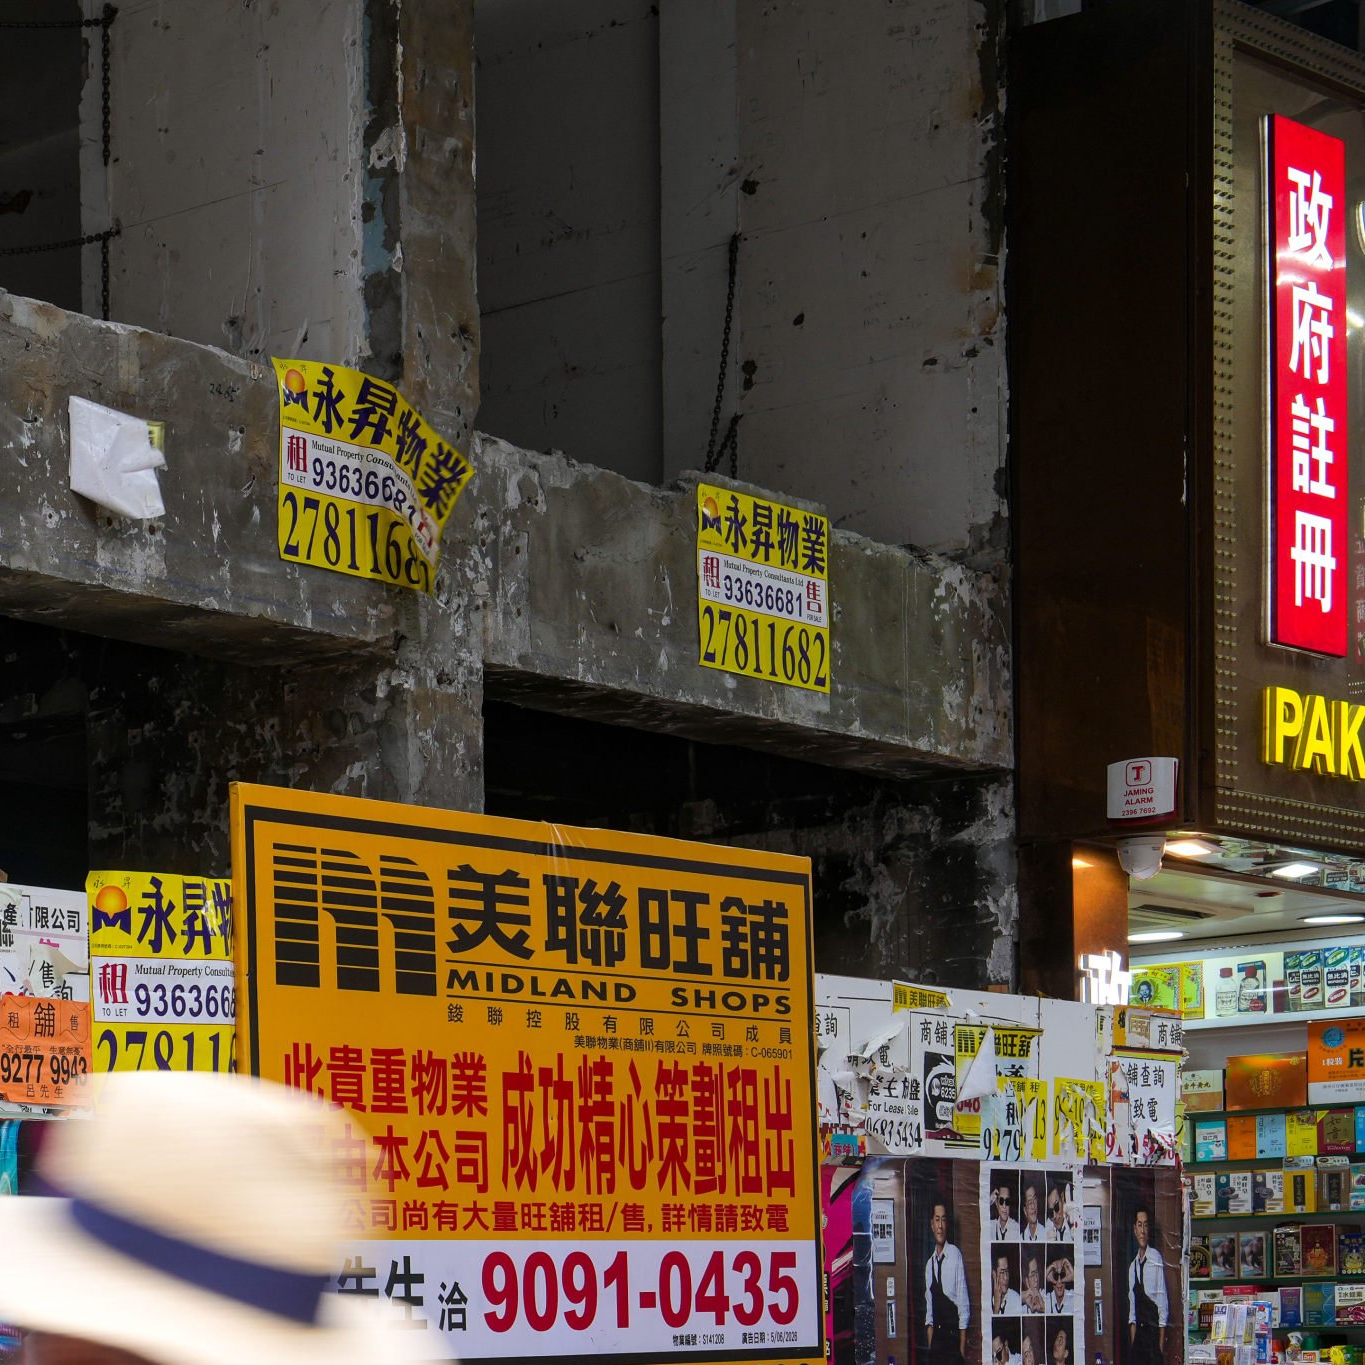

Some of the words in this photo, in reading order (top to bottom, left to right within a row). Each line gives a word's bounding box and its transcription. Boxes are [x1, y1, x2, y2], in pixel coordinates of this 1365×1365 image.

[1286, 164, 1336, 614] 政府註冊
[312, 440, 335, 454] Mutual
[337, 447, 364, 462] Property
[313, 366, 468, 519] 永昇物業
[725, 494, 826, 575] 永昇物業
[724, 575, 802, 617] 93636681
[703, 606, 827, 688] 27811682
[1124, 787, 1154, 797] JAMING
[1125, 797, 1153, 806] ALARM
[446, 864, 791, 984] 美聯旺舖
[98, 961, 129, 1004] 租
[446, 968, 637, 1004] MIDLAND
[670, 986, 792, 1016] SHOPS
[102, 1007, 111, 1017] TO
[116, 1007, 128, 1017] LET
[0, 1053, 44, 1085] 9277
[50, 1055, 87, 1087] 9943
[502, 1049, 794, 1198] 成功精心策劃租出
[482, 1249, 800, 1334] 9091-0435
